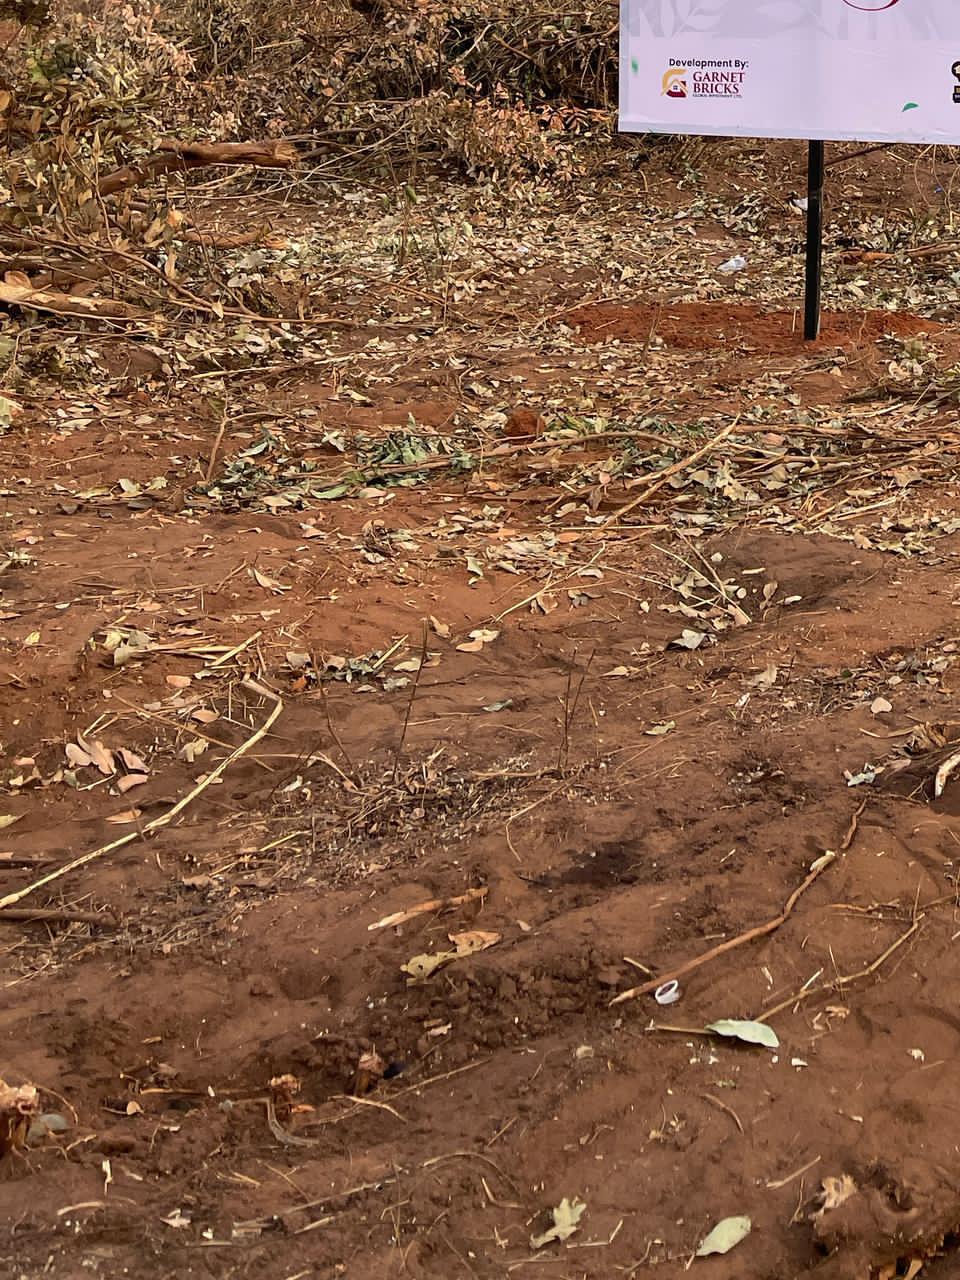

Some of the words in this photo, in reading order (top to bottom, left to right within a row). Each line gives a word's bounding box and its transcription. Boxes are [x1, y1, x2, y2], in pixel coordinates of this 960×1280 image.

[669, 58, 732, 69] Development
[734, 60, 749, 70] By:
[692, 71, 745, 83] GARNET
[693, 82, 739, 94] BRICKS
